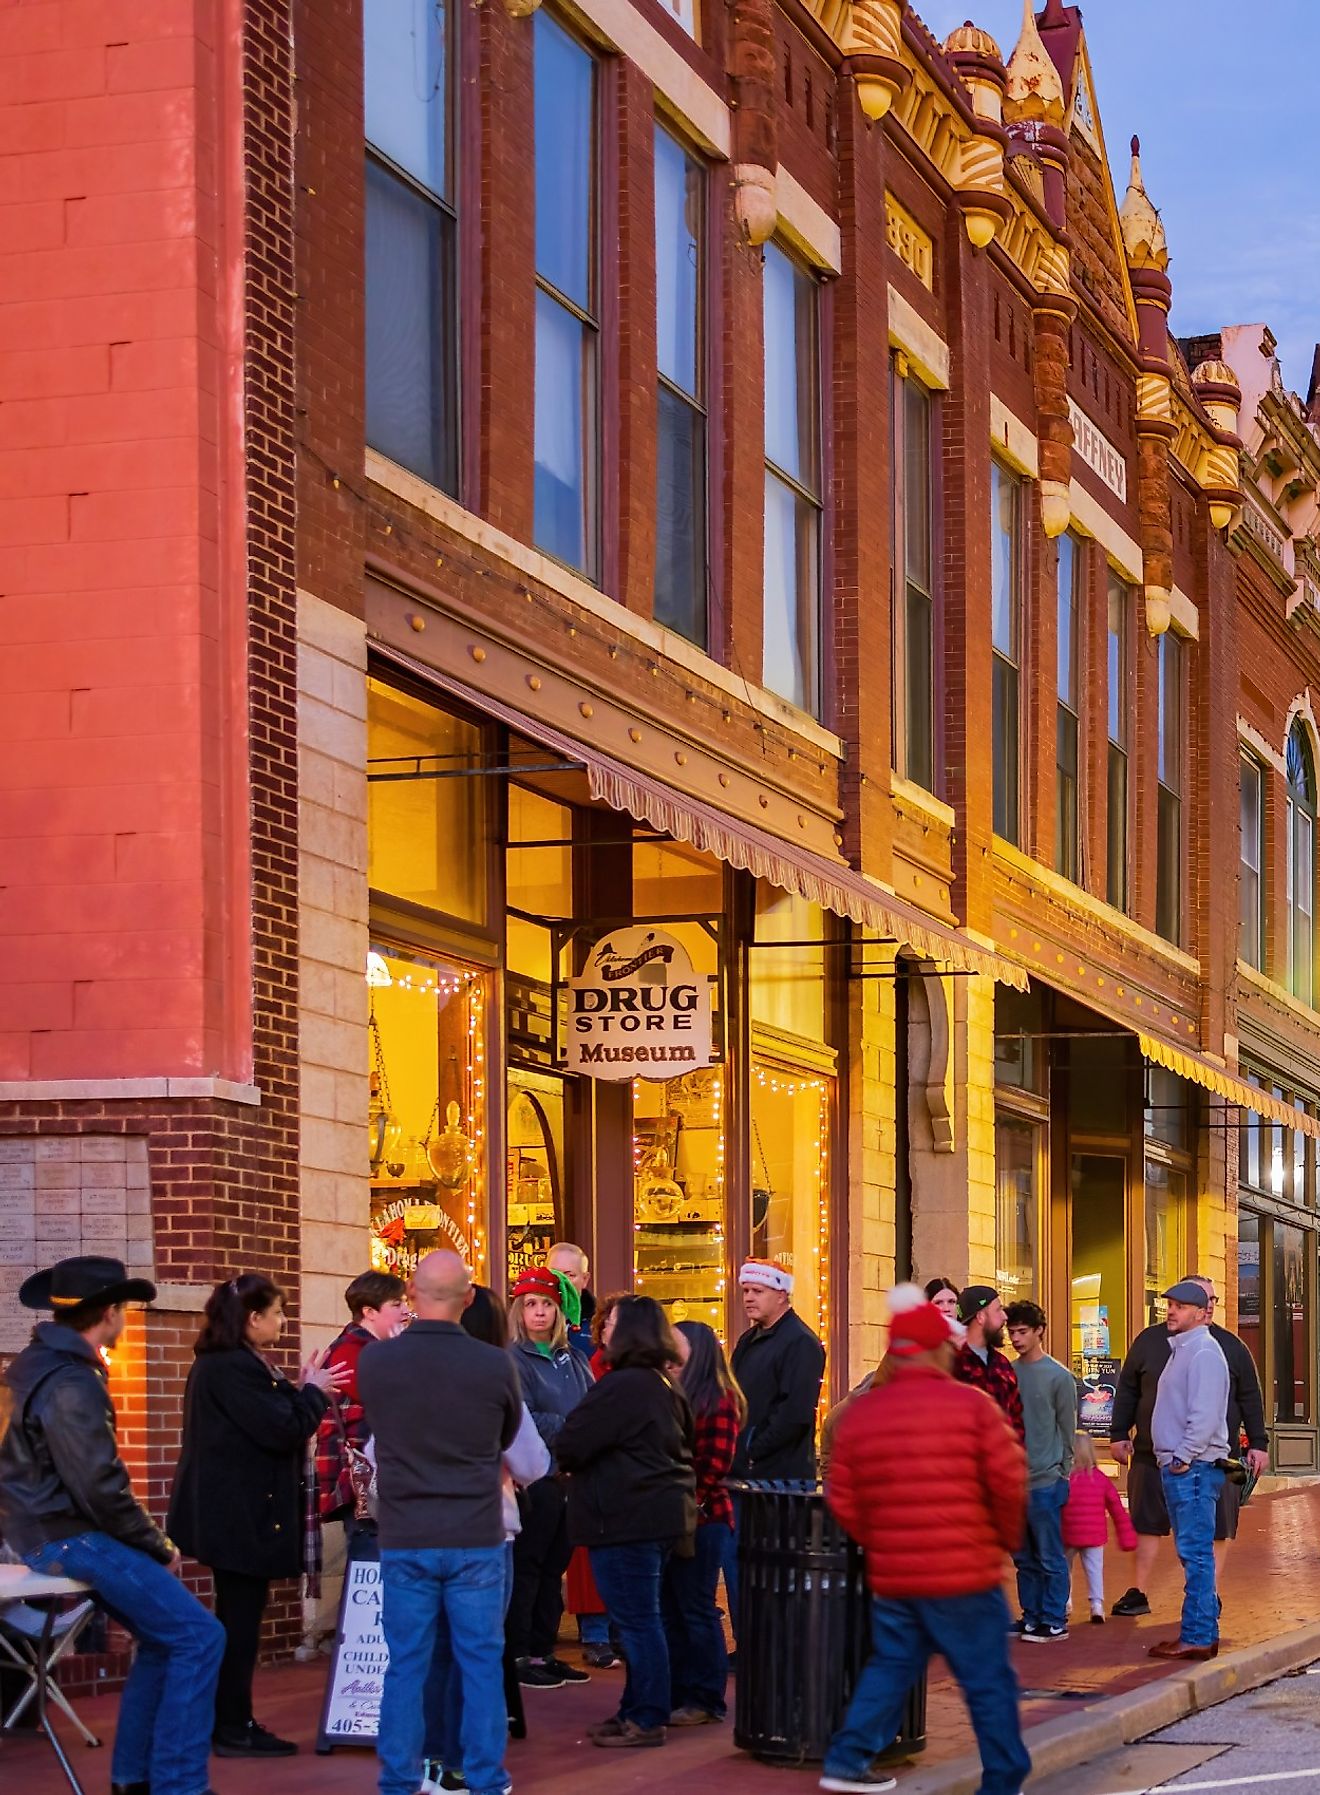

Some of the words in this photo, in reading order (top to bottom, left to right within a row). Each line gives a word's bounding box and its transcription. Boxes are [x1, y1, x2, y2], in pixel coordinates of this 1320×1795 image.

[1071, 410, 1124, 495] AFFNEY
[608, 947, 664, 979] FRONTIER
[572, 985, 699, 1013] DRUG
[575, 1014, 692, 1033] STORE
[579, 1043, 696, 1064] Museum
[354, 1568, 382, 1584] HO
